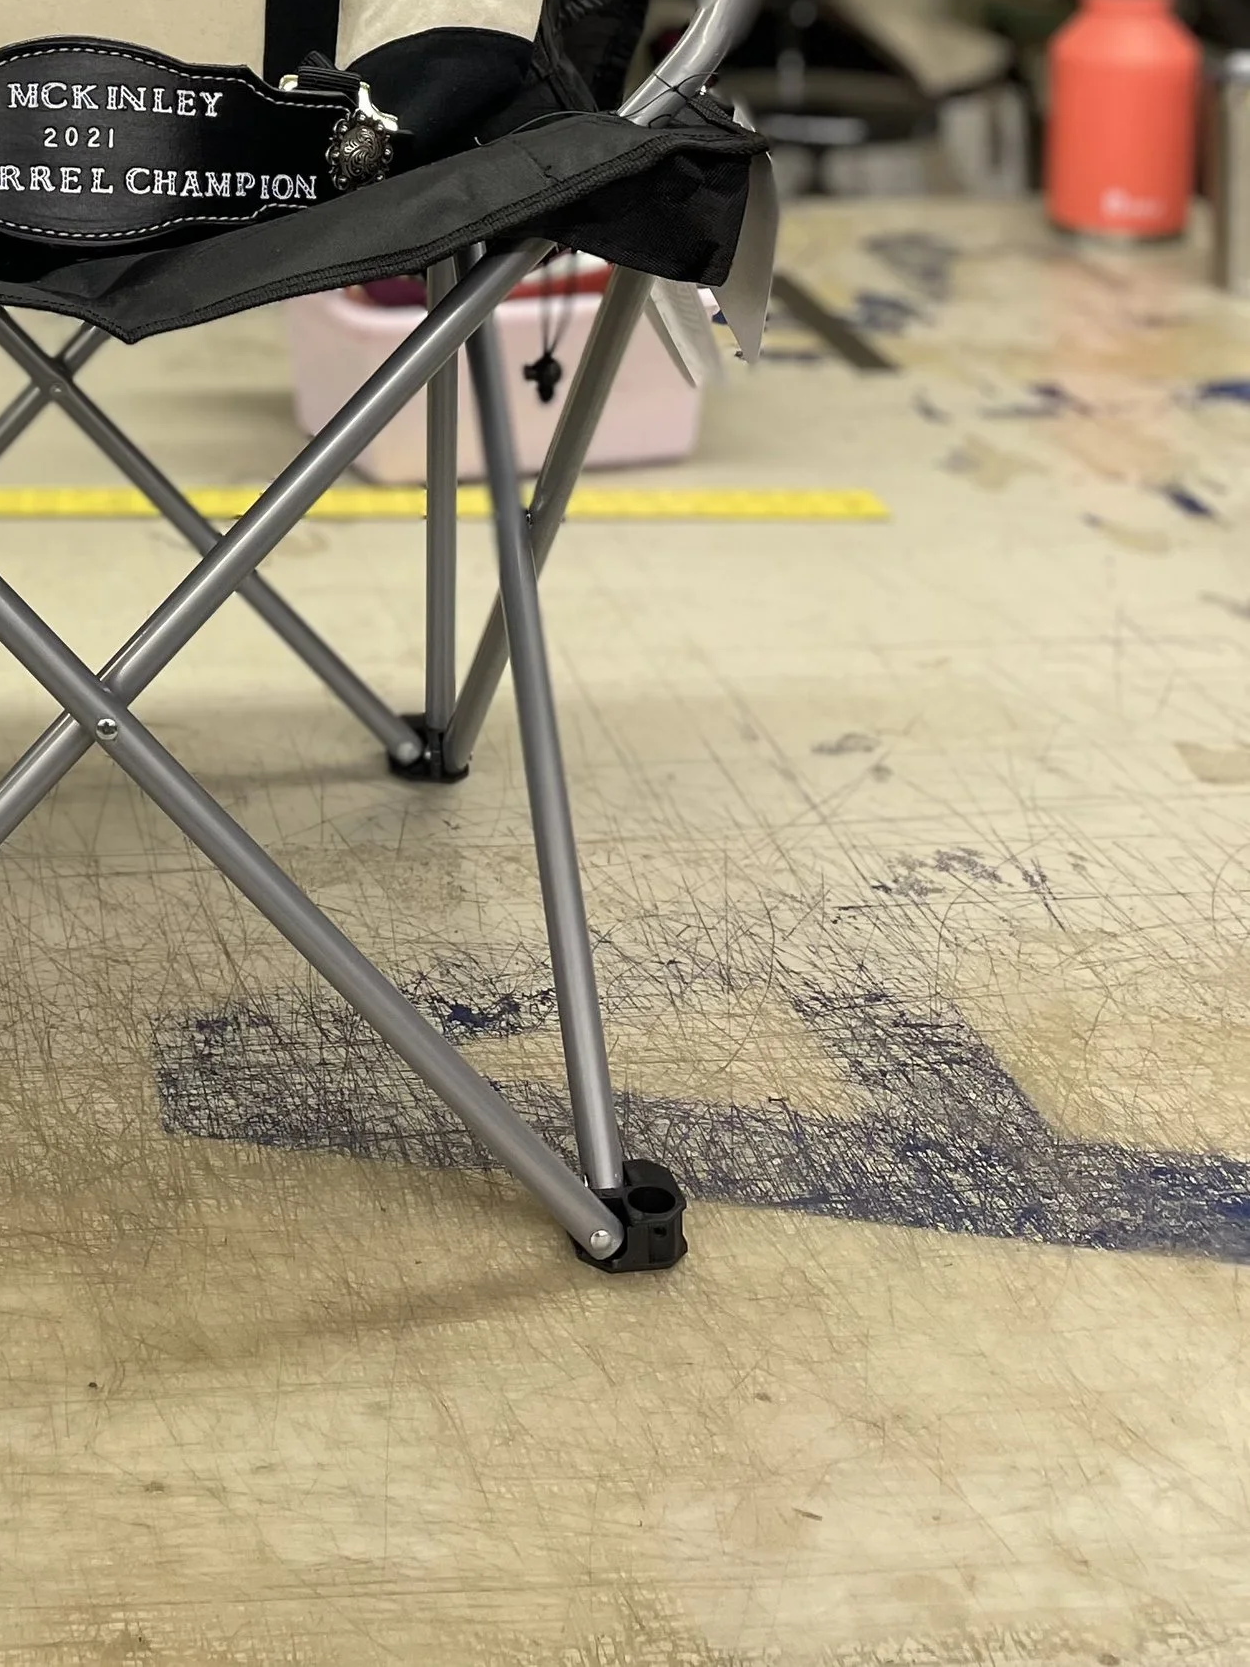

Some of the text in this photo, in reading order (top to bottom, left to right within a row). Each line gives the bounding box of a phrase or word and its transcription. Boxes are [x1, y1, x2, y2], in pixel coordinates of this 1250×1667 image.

[7, 81, 223, 117] MCKINLEY
[43, 126, 114, 149] 2021
[125, 167, 318, 200] CHAMPION
